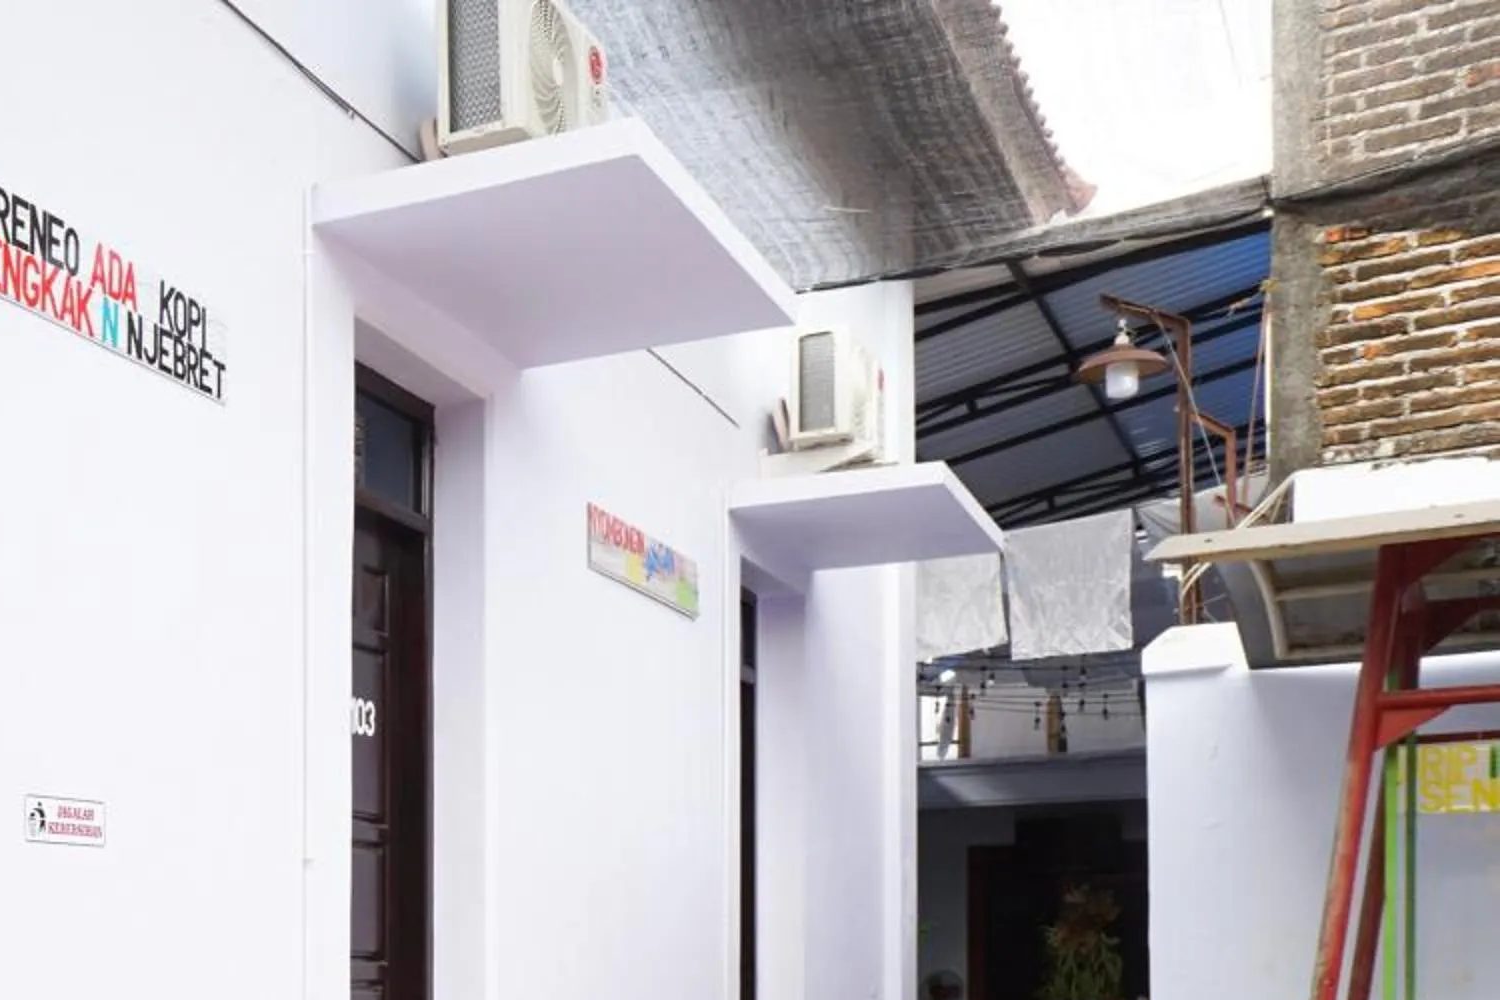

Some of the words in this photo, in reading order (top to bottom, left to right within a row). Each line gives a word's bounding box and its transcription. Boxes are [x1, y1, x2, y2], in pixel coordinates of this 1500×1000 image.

[91, 242, 138, 312] ADA
[160, 279, 207, 352] KOPI
[102, 296, 119, 348] N
[127, 310, 226, 399] NJEBRET
